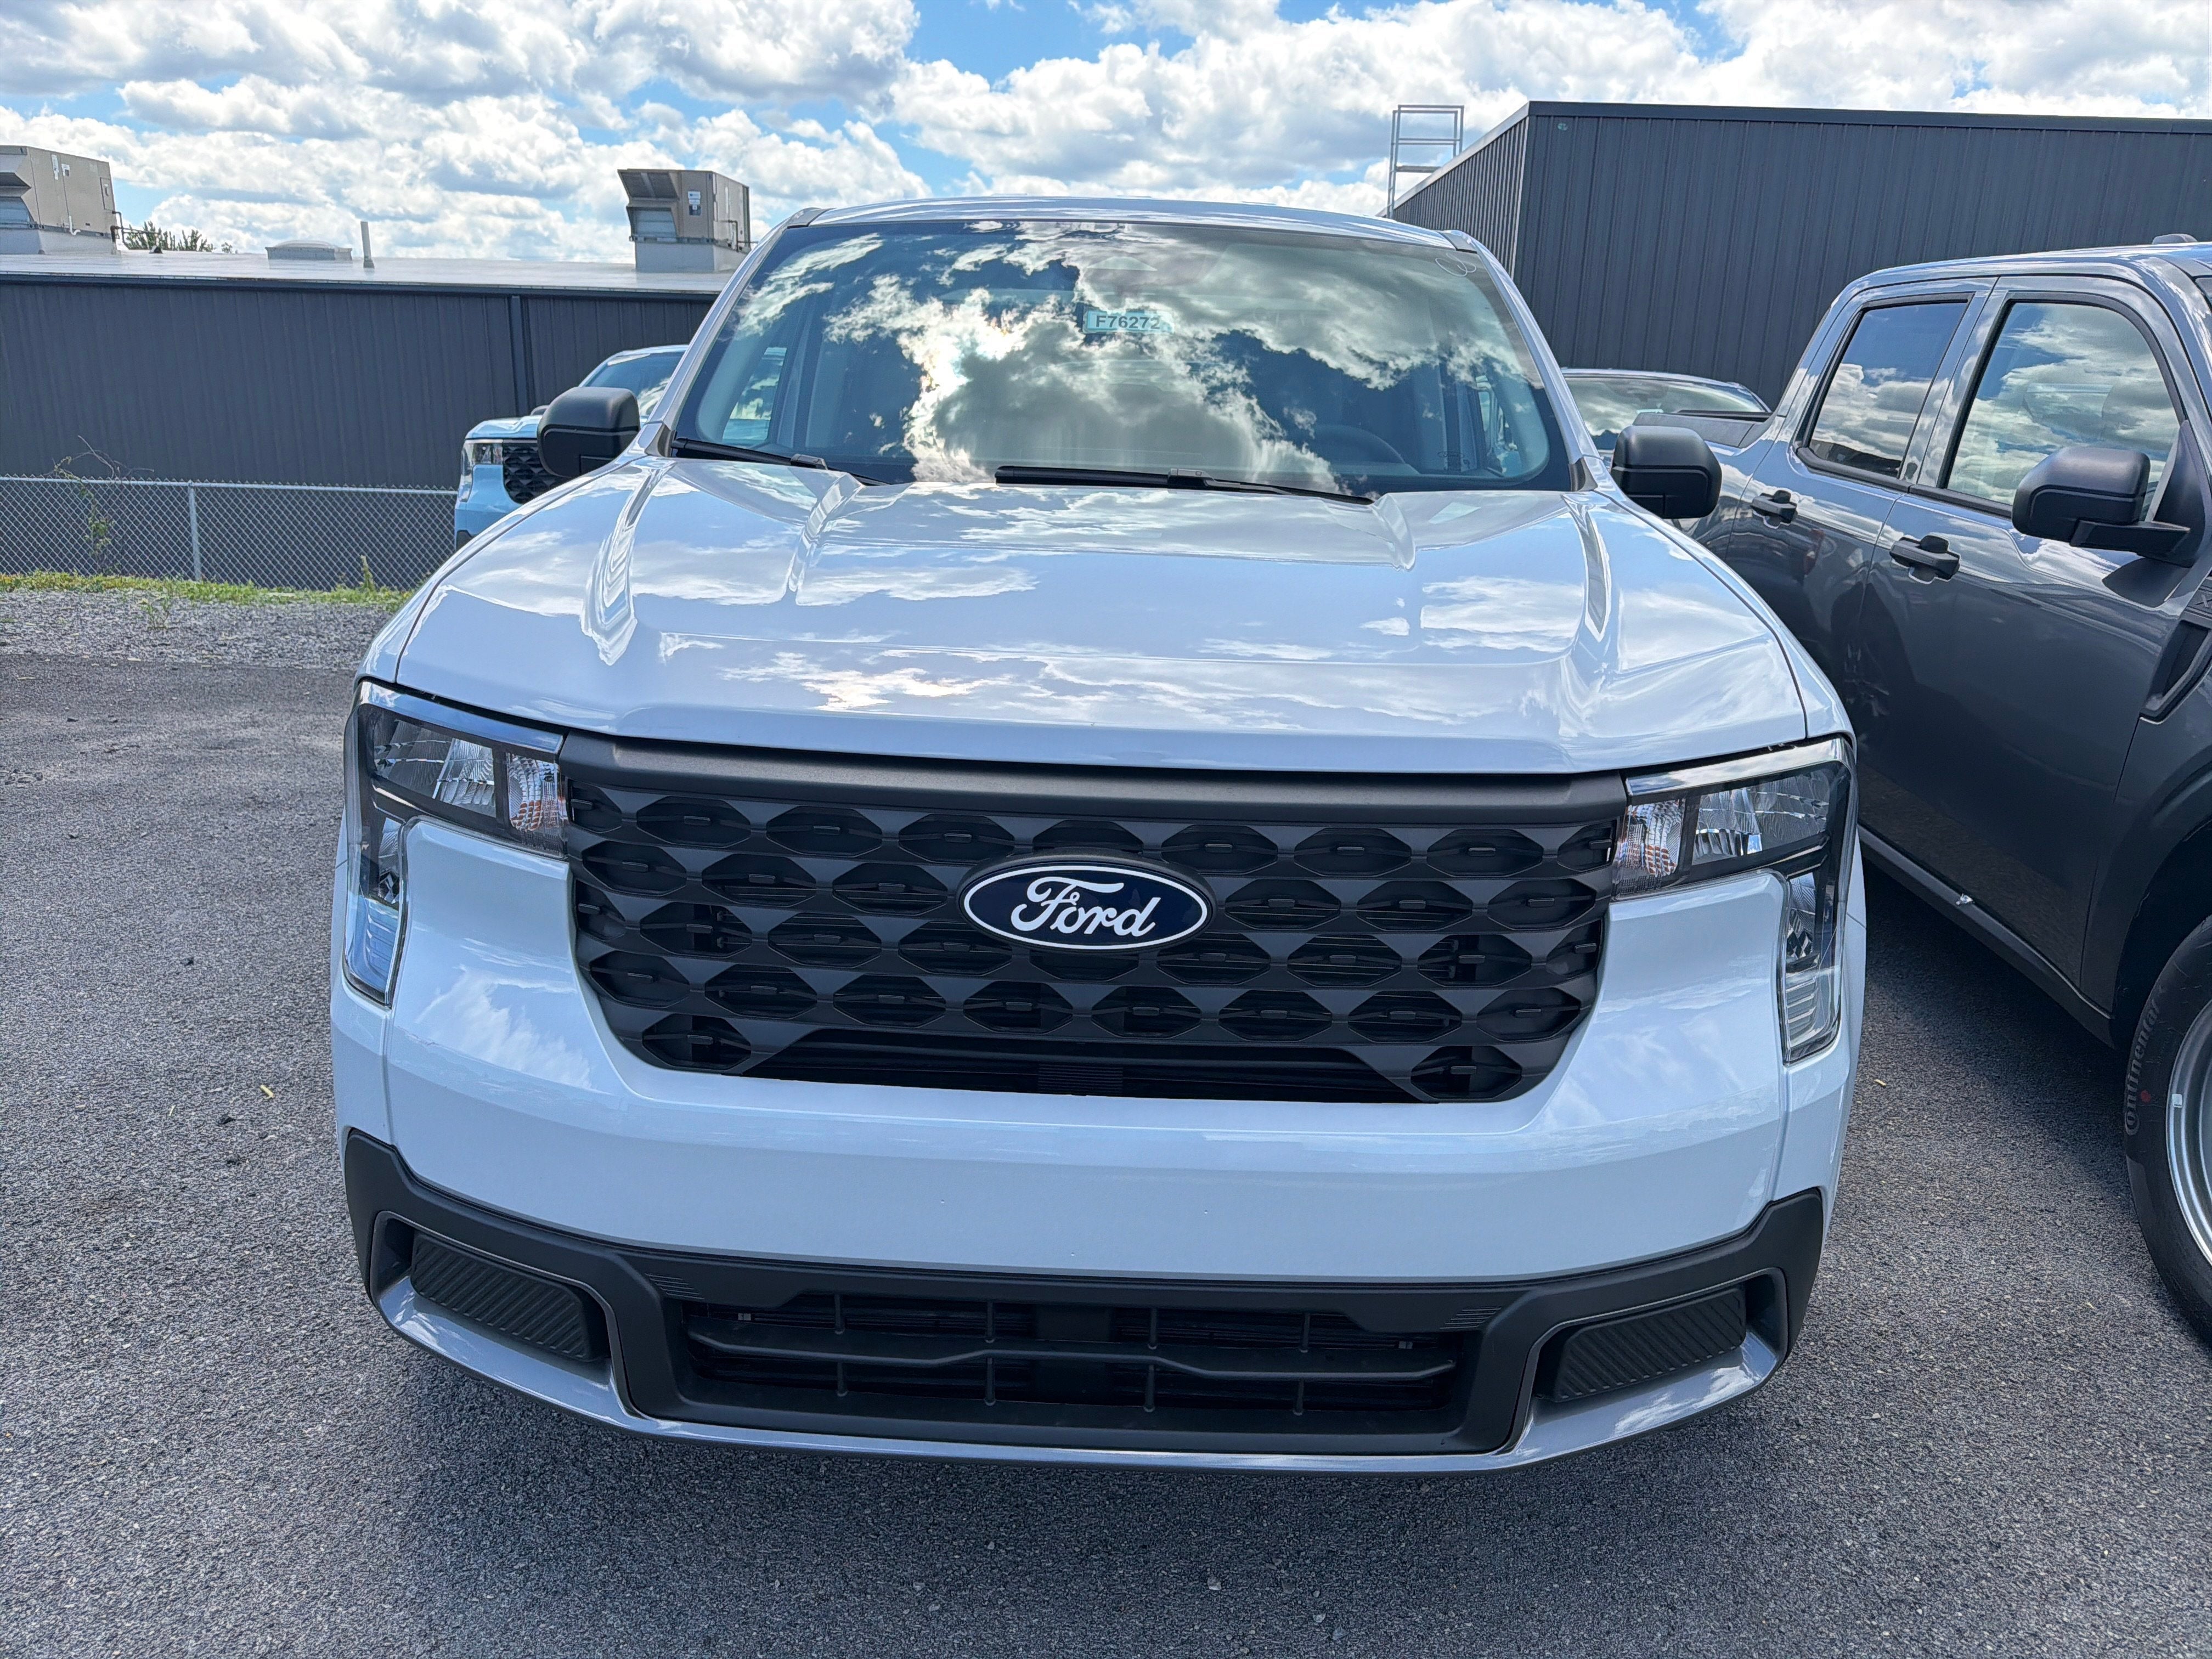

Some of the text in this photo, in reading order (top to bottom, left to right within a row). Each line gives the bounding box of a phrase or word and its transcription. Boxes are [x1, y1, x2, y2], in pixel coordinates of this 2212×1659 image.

[1096, 315, 1160, 329] F76272
[1011, 876, 1161, 937] Ford
[2124, 998, 2160, 1136] Continental
